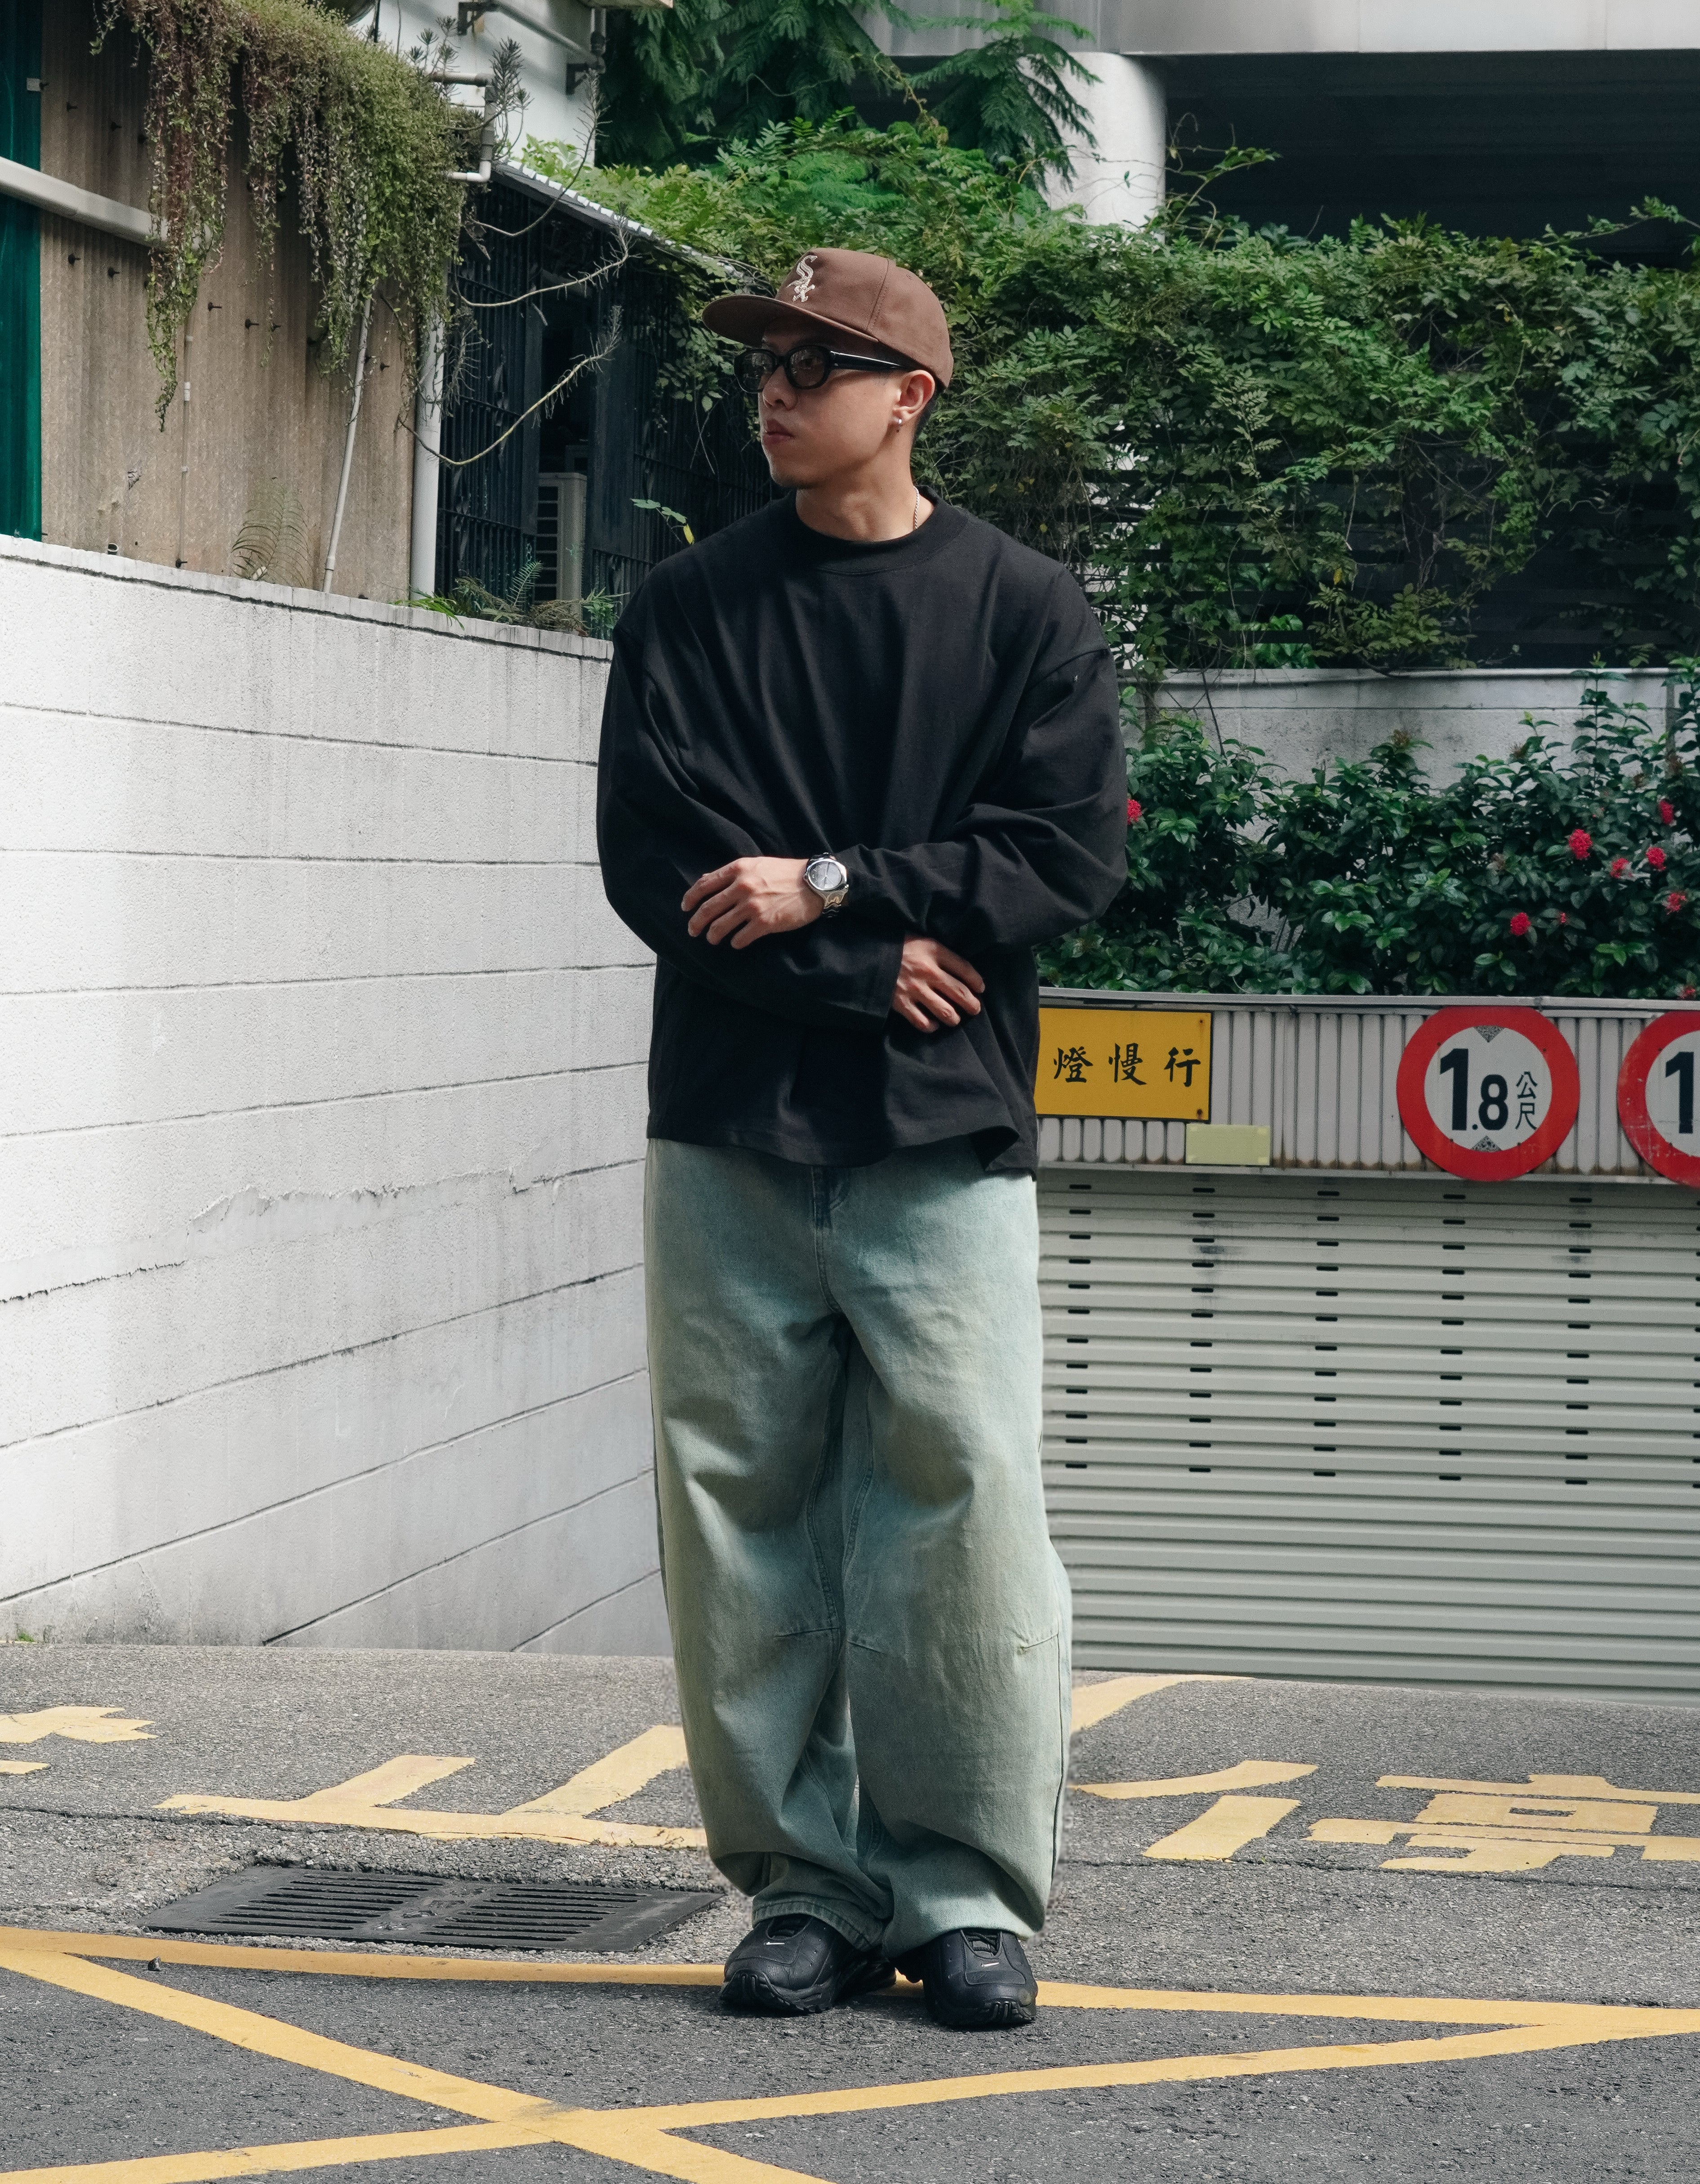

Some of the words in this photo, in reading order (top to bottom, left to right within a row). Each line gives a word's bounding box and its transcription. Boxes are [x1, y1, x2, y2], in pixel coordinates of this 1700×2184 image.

[1054, 1043, 1201, 1087] 燈慢行
[1440, 1048, 1509, 1131] 1.8
[1515, 1071, 1538, 1130] 公尺
